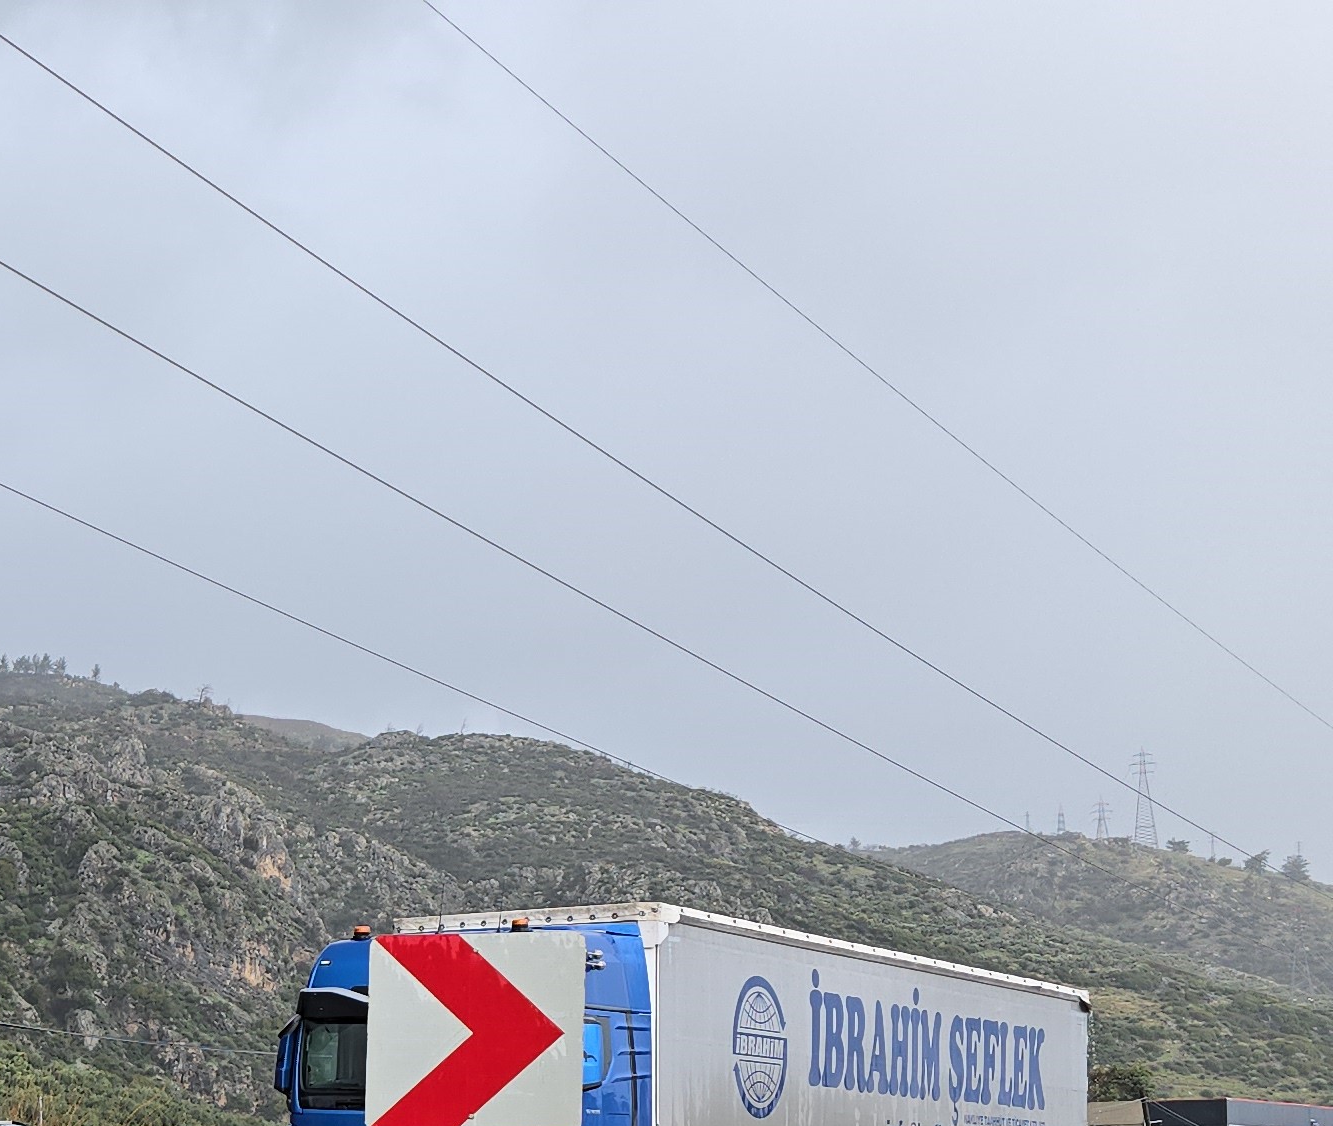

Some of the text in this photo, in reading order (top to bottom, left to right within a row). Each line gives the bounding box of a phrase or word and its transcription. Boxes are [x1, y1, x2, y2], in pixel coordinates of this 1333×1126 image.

[735, 1034, 784, 1059] İBRAHİM
[808, 968, 1046, 1126] İBRAHİM ŞEFLEK
